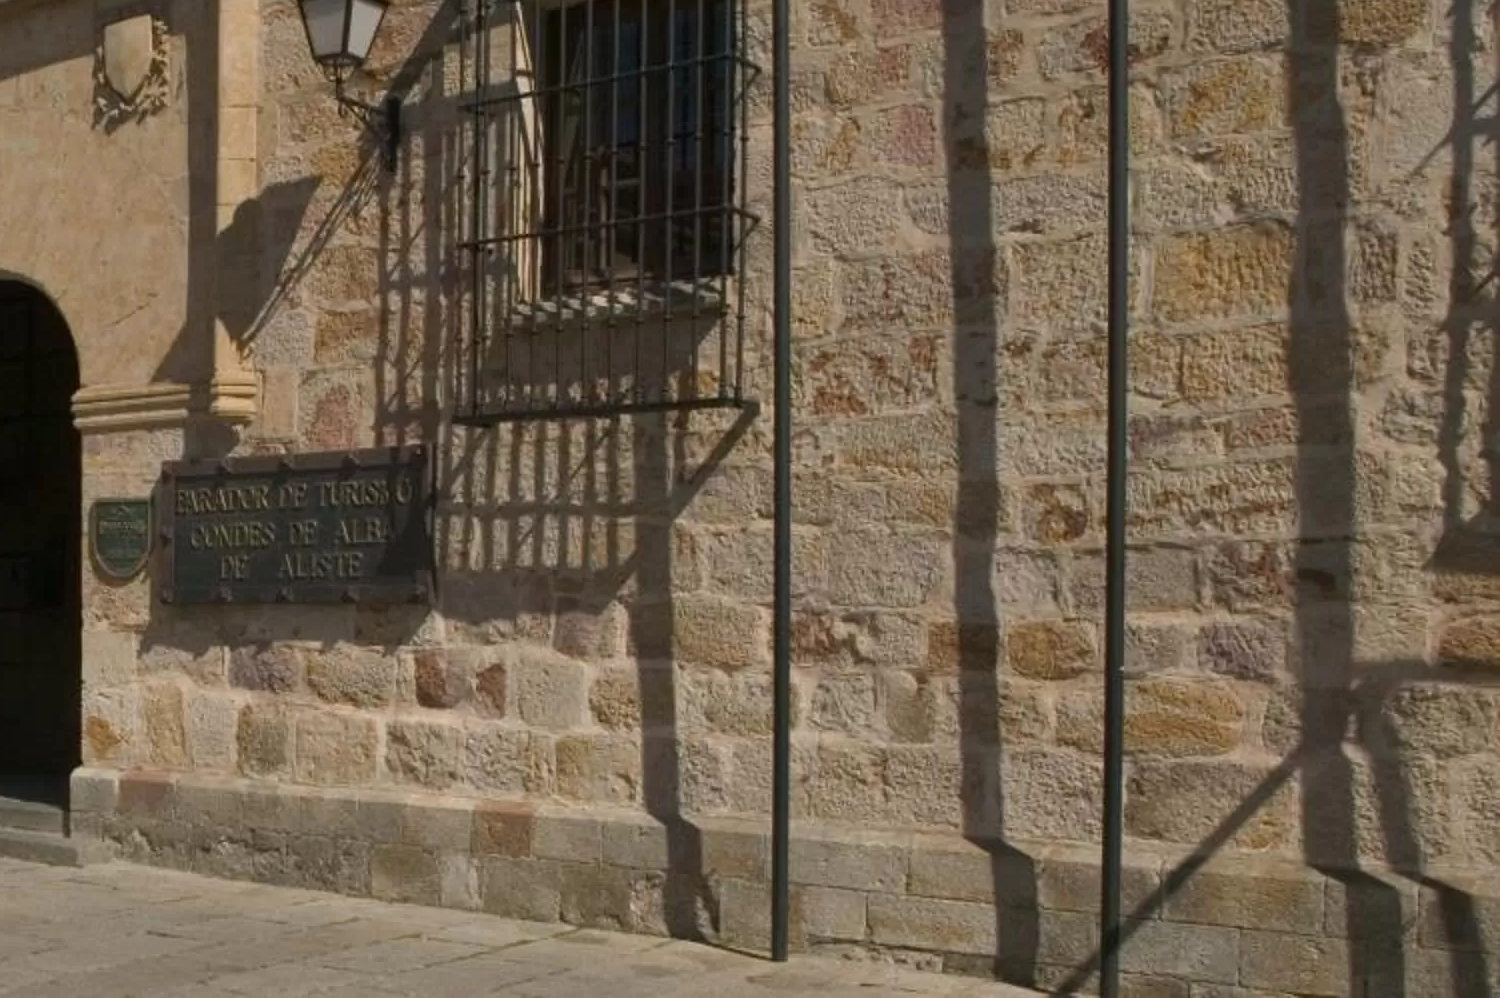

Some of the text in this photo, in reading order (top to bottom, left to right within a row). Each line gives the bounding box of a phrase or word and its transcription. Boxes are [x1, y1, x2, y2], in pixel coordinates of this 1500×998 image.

[175, 484, 269, 514] PARADOR
[278, 482, 309, 507] DE
[190, 516, 394, 549] CONDES DE ALB
[220, 552, 364, 580] DE ALISTE
